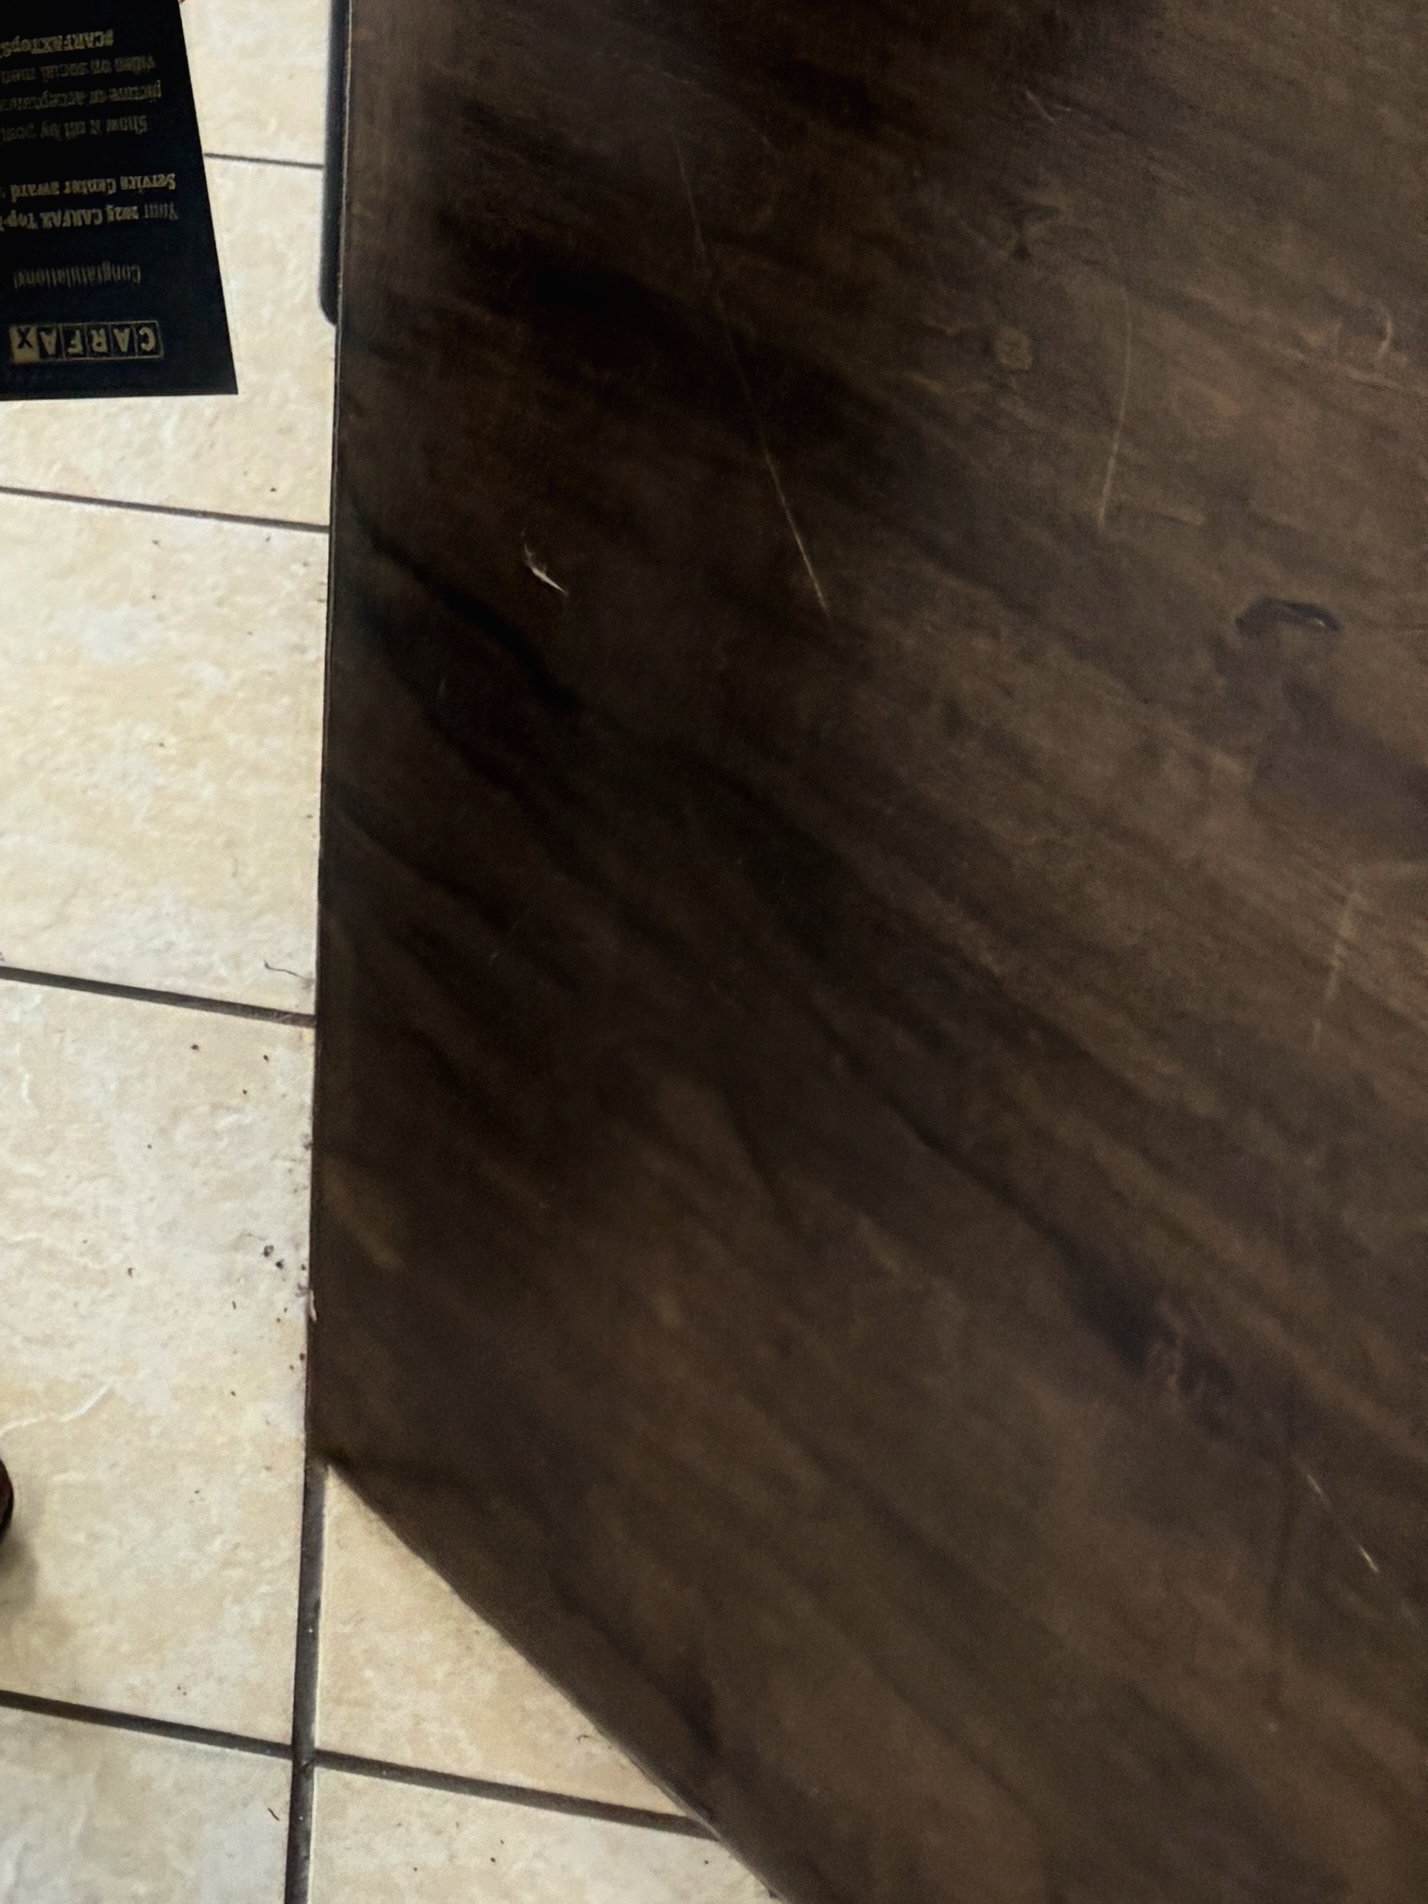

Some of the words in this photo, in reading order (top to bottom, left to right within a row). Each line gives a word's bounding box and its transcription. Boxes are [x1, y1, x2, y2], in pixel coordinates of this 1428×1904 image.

[58, 178, 116, 195] Center
[121, 172, 177, 191] Service
[44, 208, 104, 230] CARFAX
[14, 262, 142, 289] Congratulations!
[11, 321, 162, 363] CARFAX
